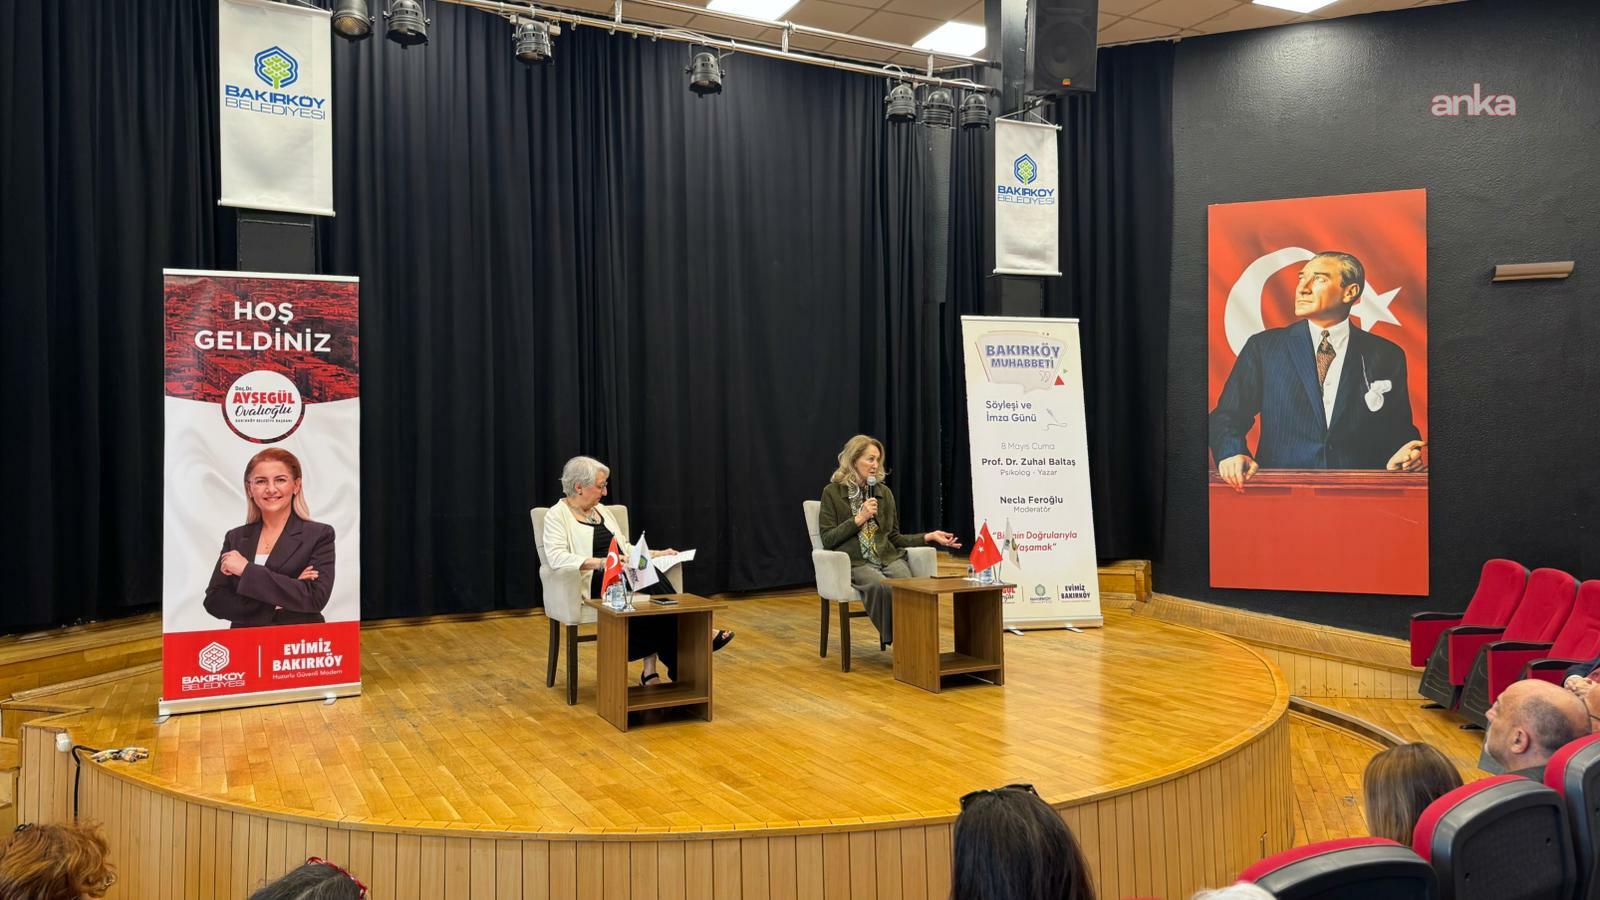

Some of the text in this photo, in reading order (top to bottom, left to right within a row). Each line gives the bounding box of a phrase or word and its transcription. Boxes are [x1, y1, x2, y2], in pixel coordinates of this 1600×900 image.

[225, 85, 325, 109] BAKIRKÖY
[234, 301, 294, 325] HOŞ
[194, 328, 331, 353] GELDİNİZ
[986, 342, 1060, 360] BAKIRKÖY
[991, 356, 1054, 369] MUHABBETİ
[233, 390, 295, 406] AYŞEGÜL
[986, 400, 1018, 411] Söyleşi
[986, 411, 1037, 422] İmza Günü
[1031, 442, 1055, 450] Cuma
[982, 457, 1076, 468] Prof. Dr. Zuhal Baltaş
[1000, 469, 1031, 478] Psikolog
[1000, 496, 1063, 506] Necla Feroğlu
[1026, 530, 1077, 542] Doğrularıyla
[1064, 583, 1086, 592] EVİMİZ
[284, 638, 331, 656] EVİMİZ
[272, 653, 343, 672] BAKIRKÖY
[296, 670, 319, 679] Güvenli
[320, 668, 343, 677] Modern
